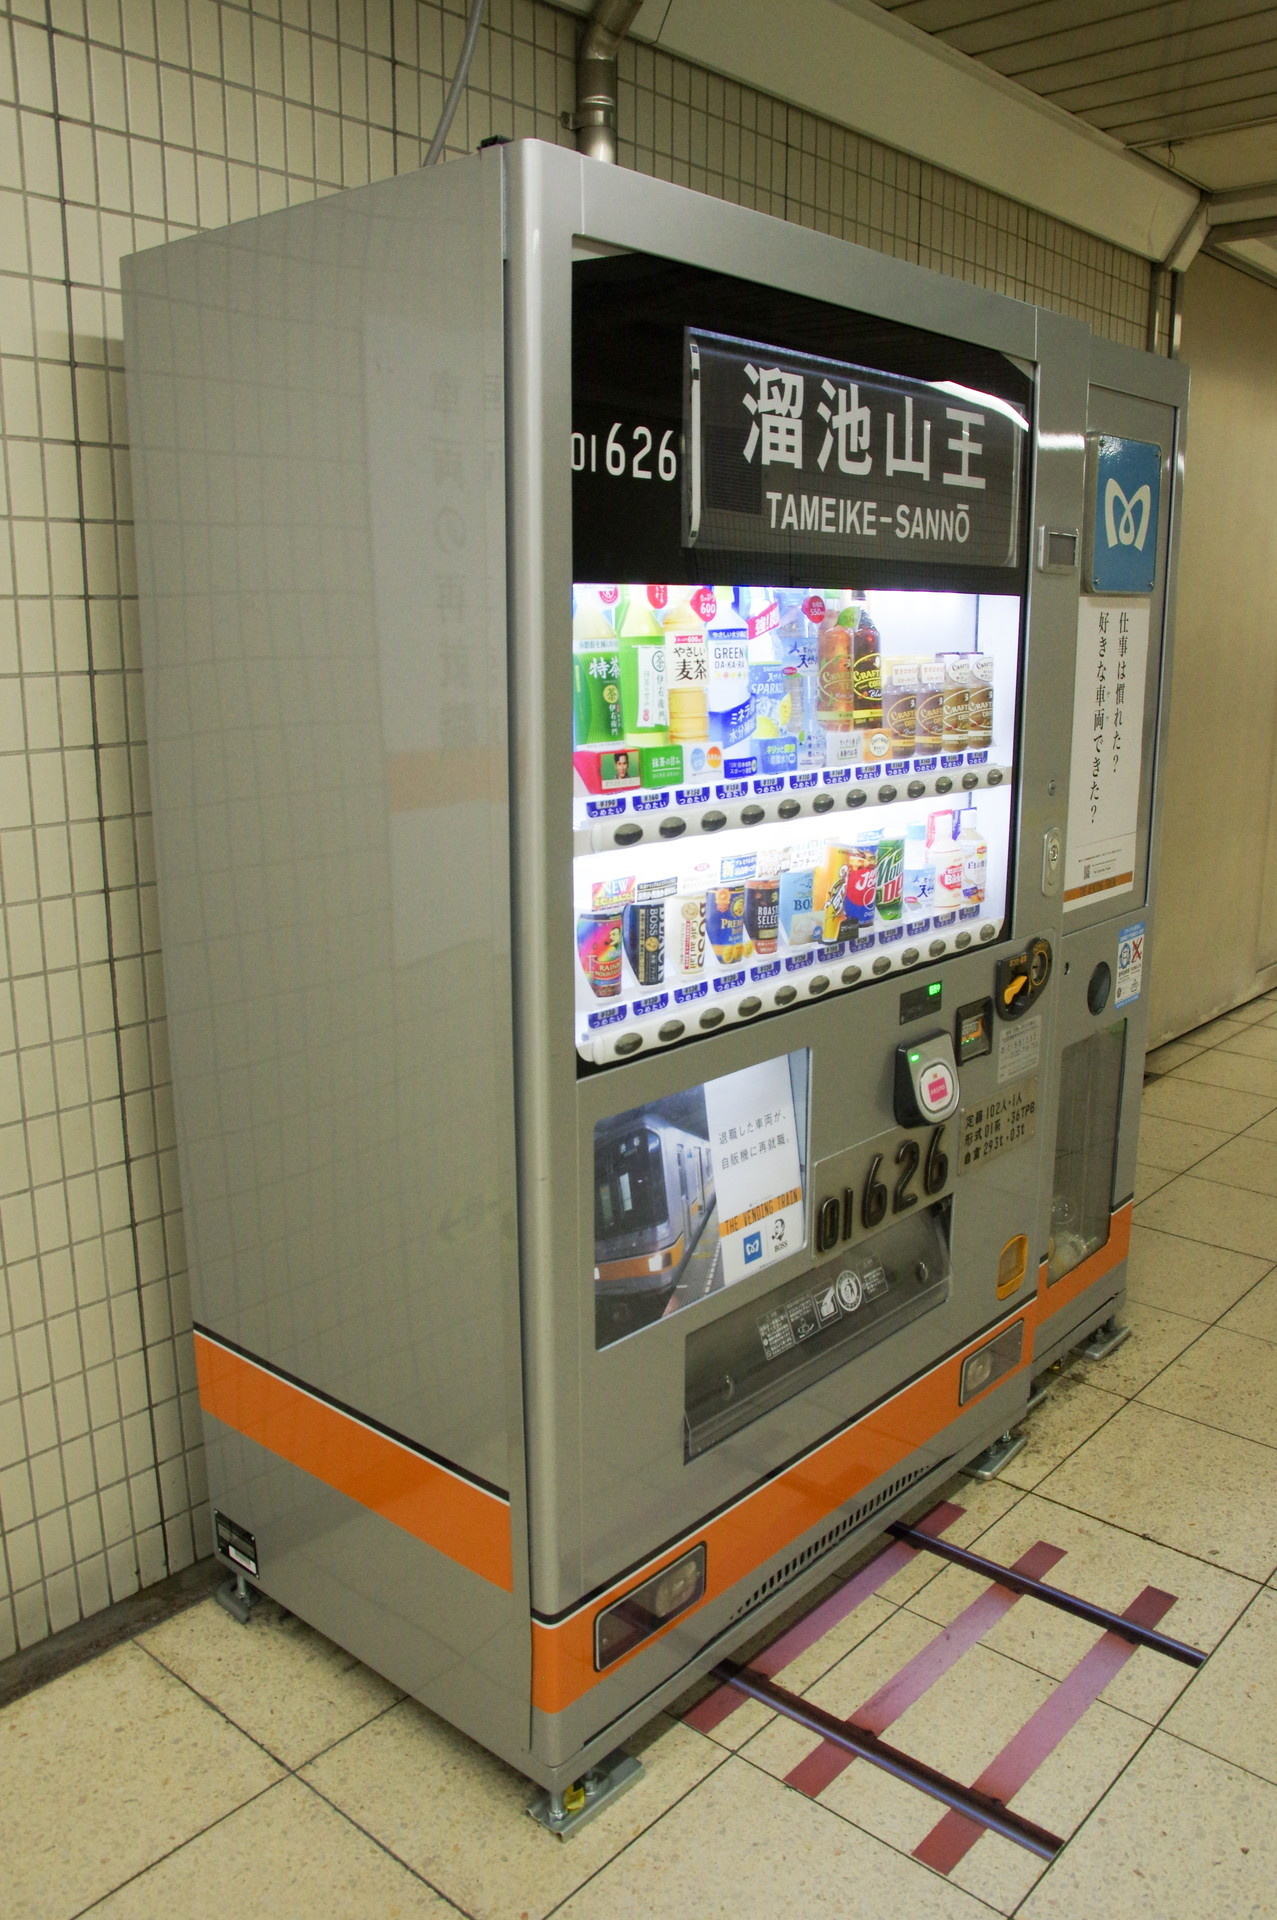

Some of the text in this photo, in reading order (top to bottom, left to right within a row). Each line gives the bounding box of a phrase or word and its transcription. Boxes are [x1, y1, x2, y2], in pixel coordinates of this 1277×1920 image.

[743, 363, 986, 489] 溜池山王
[571, 422, 677, 481] 01626
[674, 646, 703, 658] やさしい
[714, 647, 744, 659] GREEN
[588, 656, 620, 679] 特茶
[675, 658, 707, 681] 麦茶
[825, 776, 849, 784] つめたい
[857, 772, 879, 781] つめたい
[756, 785, 782, 795] つめたい
[793, 780, 816, 789] つめたい
[679, 795, 708, 806] つめたい
[719, 791, 746, 800] つめたい
[592, 807, 623, 818] つめたい
[636, 801, 667, 812] つめたい
[649, 907, 659, 937] BOSS
[754, 969, 780, 981] つめたい
[717, 981, 743, 992] つめたい
[678, 991, 706, 1003] つめたい
[637, 1002, 666, 1016] つめたい
[594, 1015, 624, 1029] つめたい
[718, 1109, 787, 1145] 退職した車両が、
[721, 1133, 791, 1170] 自販機に再就職。
[816, 1124, 949, 1253] 01626
[724, 1185, 799, 1235] THE VENDING TRAIN
[774, 1241, 788, 1253] BOSS
